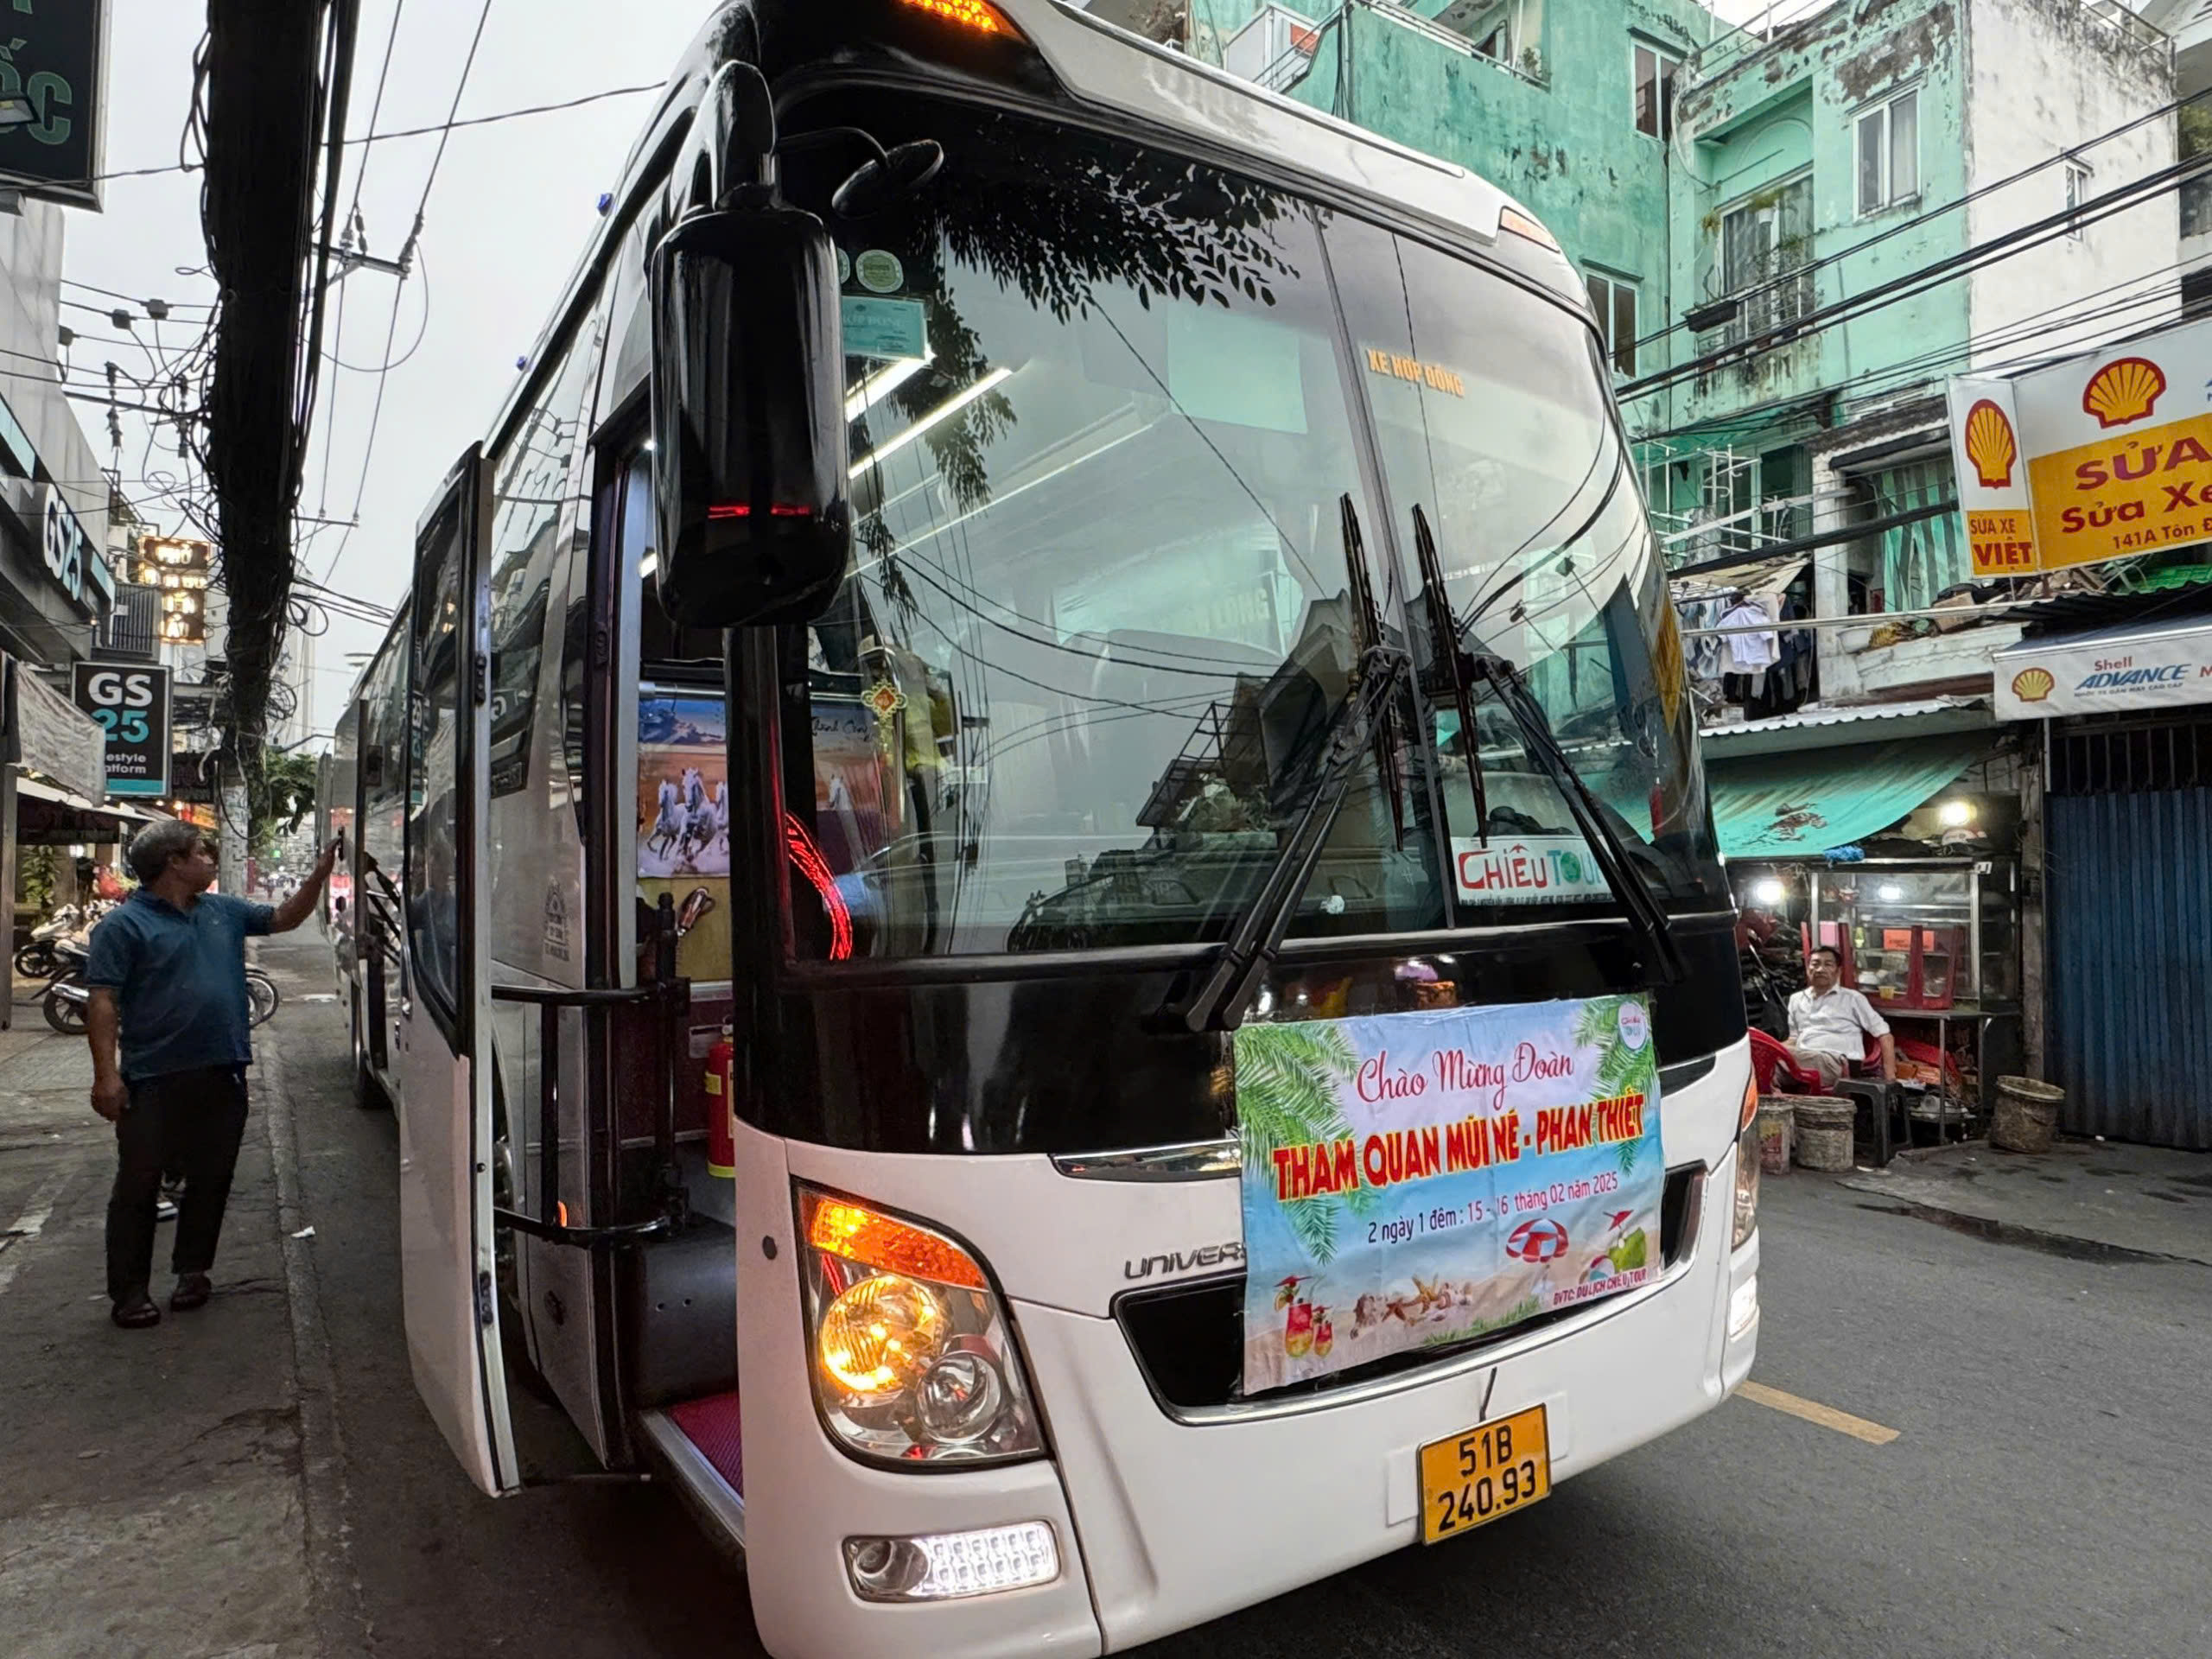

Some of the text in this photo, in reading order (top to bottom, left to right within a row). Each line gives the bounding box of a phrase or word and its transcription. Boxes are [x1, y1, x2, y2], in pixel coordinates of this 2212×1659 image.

[1999, 518, 2017, 533] XE
[2061, 500, 2145, 534] Sửa
[43, 483, 83, 601] GS25
[1973, 537, 2033, 570] VIỆT
[2113, 528, 2158, 549] 141A
[2161, 524, 2196, 540] Tôn
[2075, 664, 2192, 690] ADVANCE
[2094, 656, 2133, 671] Shell
[88, 672, 153, 707] GS
[92, 708, 149, 743] 25
[104, 763, 147, 774] atform
[105, 753, 147, 765] estyle
[1547, 849, 1602, 887] TOU
[1356, 1042, 1574, 1110] Chào Mừng Đoàn
[1273, 1139, 1360, 1201] THAM
[1363, 1127, 1442, 1188] QUAN
[1491, 1109, 1520, 1164] NÉ
[1536, 1103, 1592, 1155] PHAN
[1597, 1086, 1644, 1143] THIẾT
[1368, 1222, 1376, 1243] 2
[1382, 1215, 1414, 1244] ngày
[1419, 1212, 1425, 1234] 1
[1429, 1208, 1457, 1230] đêm
[1467, 1200, 1483, 1221] 15
[1514, 1190, 1548, 1211] tháng
[1550, 1184, 1565, 1204] 02
[1567, 1180, 1591, 1200] năm
[1593, 1171, 1618, 1194] 2025
[1459, 1425, 1513, 1478] 51B
[1437, 1459, 1536, 1533] 240.93
